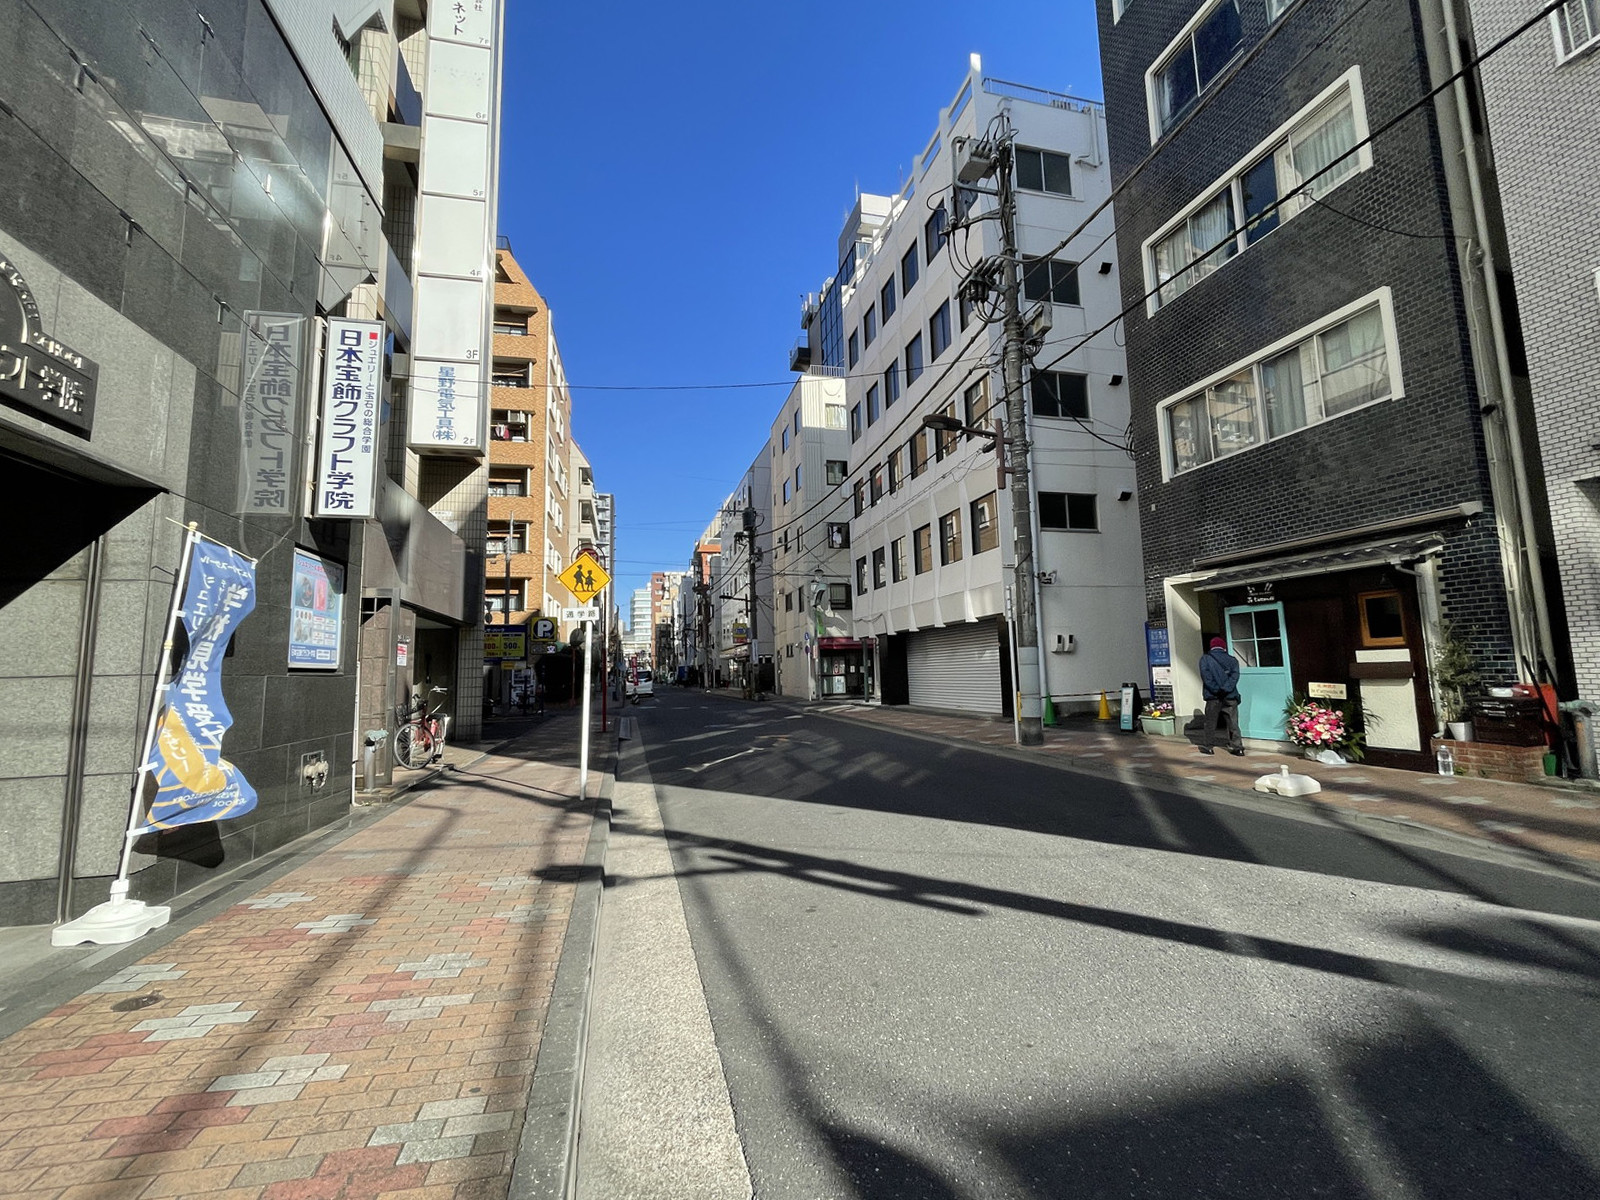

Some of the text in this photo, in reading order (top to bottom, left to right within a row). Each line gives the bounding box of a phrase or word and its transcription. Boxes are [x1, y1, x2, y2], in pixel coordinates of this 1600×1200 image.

[452, 2, 466, 35] ネット
[465, 349, 479, 359] 3F
[361, 340, 378, 453] ジュエリーと宝石の総合学園
[324, 329, 363, 510] 日本宝飾クラフト学院
[463, 436, 475, 445] 2F
[565, 609, 596, 619] 通学路
[537, 620, 553, 638] P
[503, 642, 518, 650] 500
